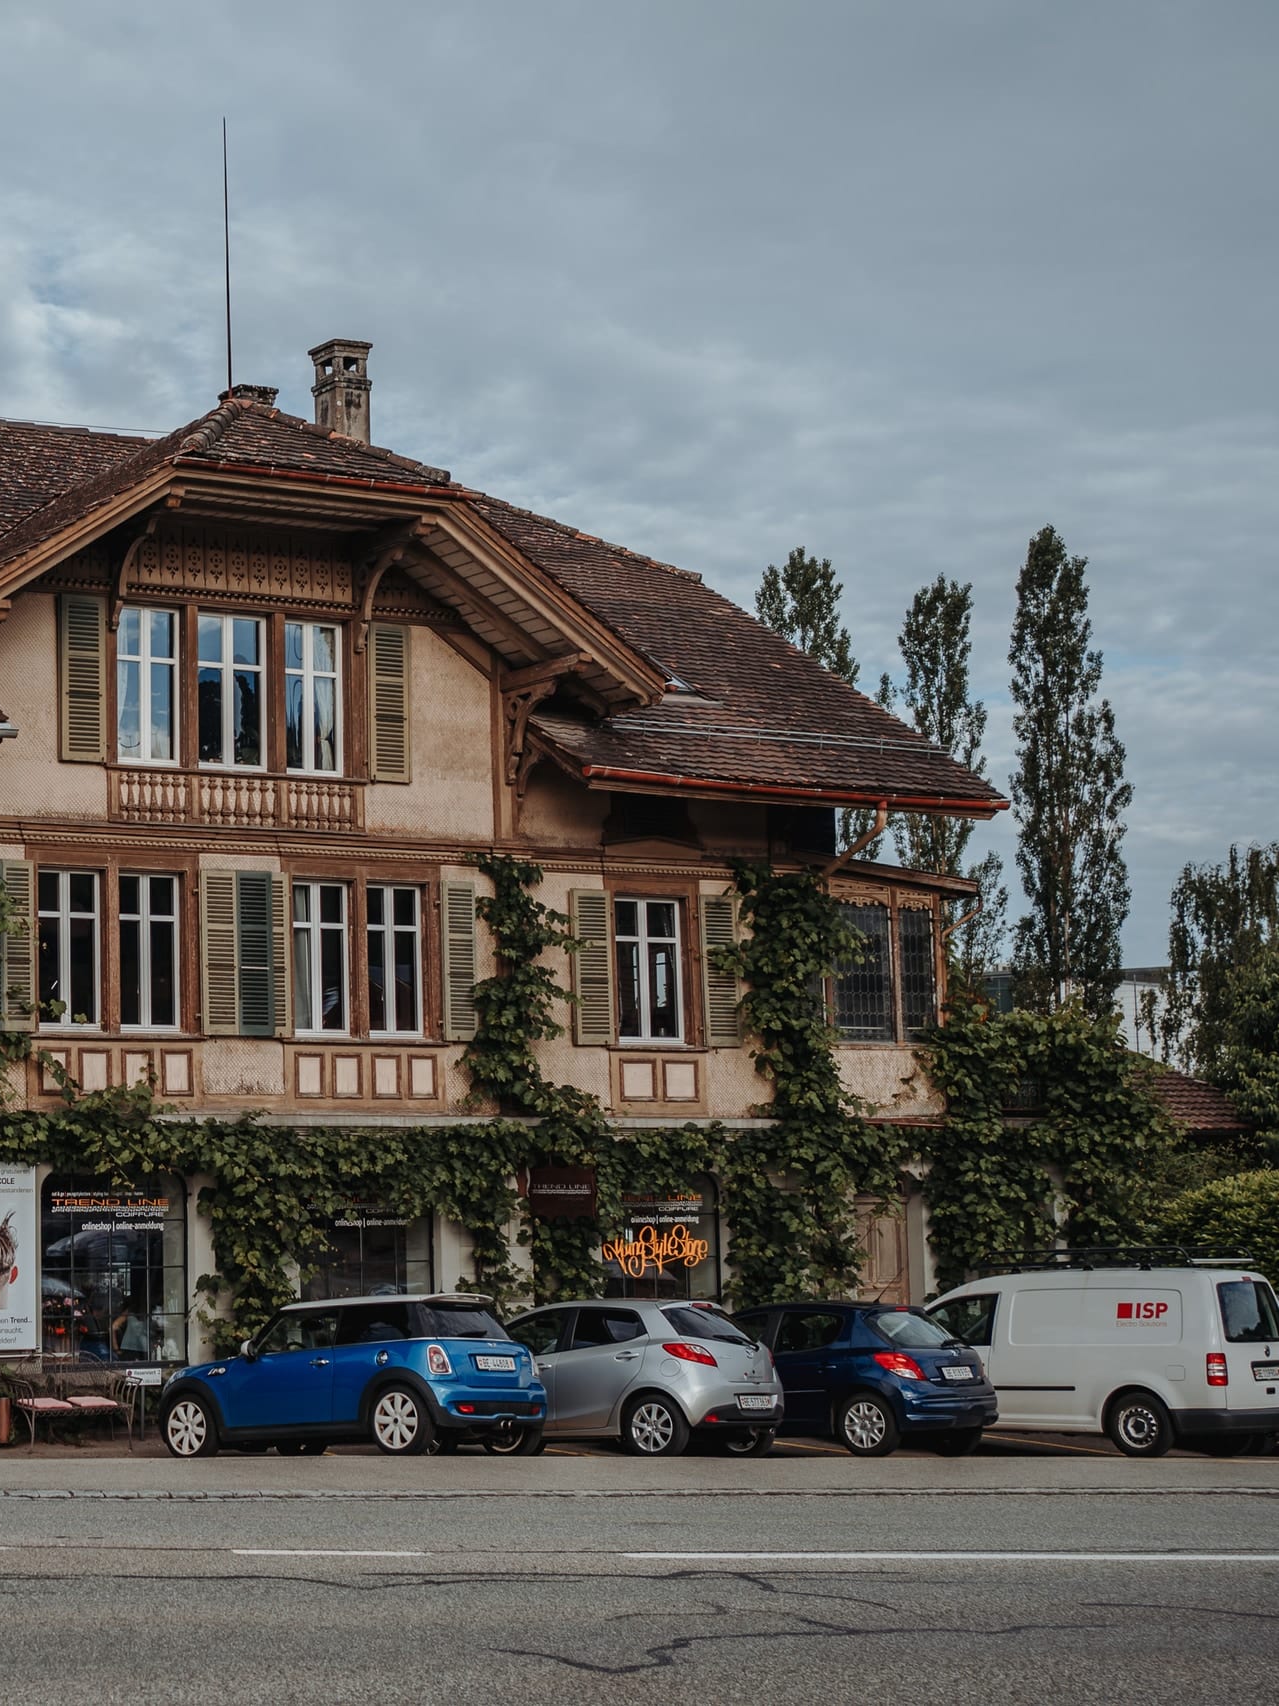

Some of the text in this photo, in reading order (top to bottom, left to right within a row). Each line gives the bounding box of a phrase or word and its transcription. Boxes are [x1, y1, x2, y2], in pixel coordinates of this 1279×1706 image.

[52, 1198, 169, 1206] TREND LINE
[82, 1221, 112, 1232] onlineshop
[116, 1220, 164, 1231] online-anmeldung
[1135, 1302, 1168, 1319] ISP
